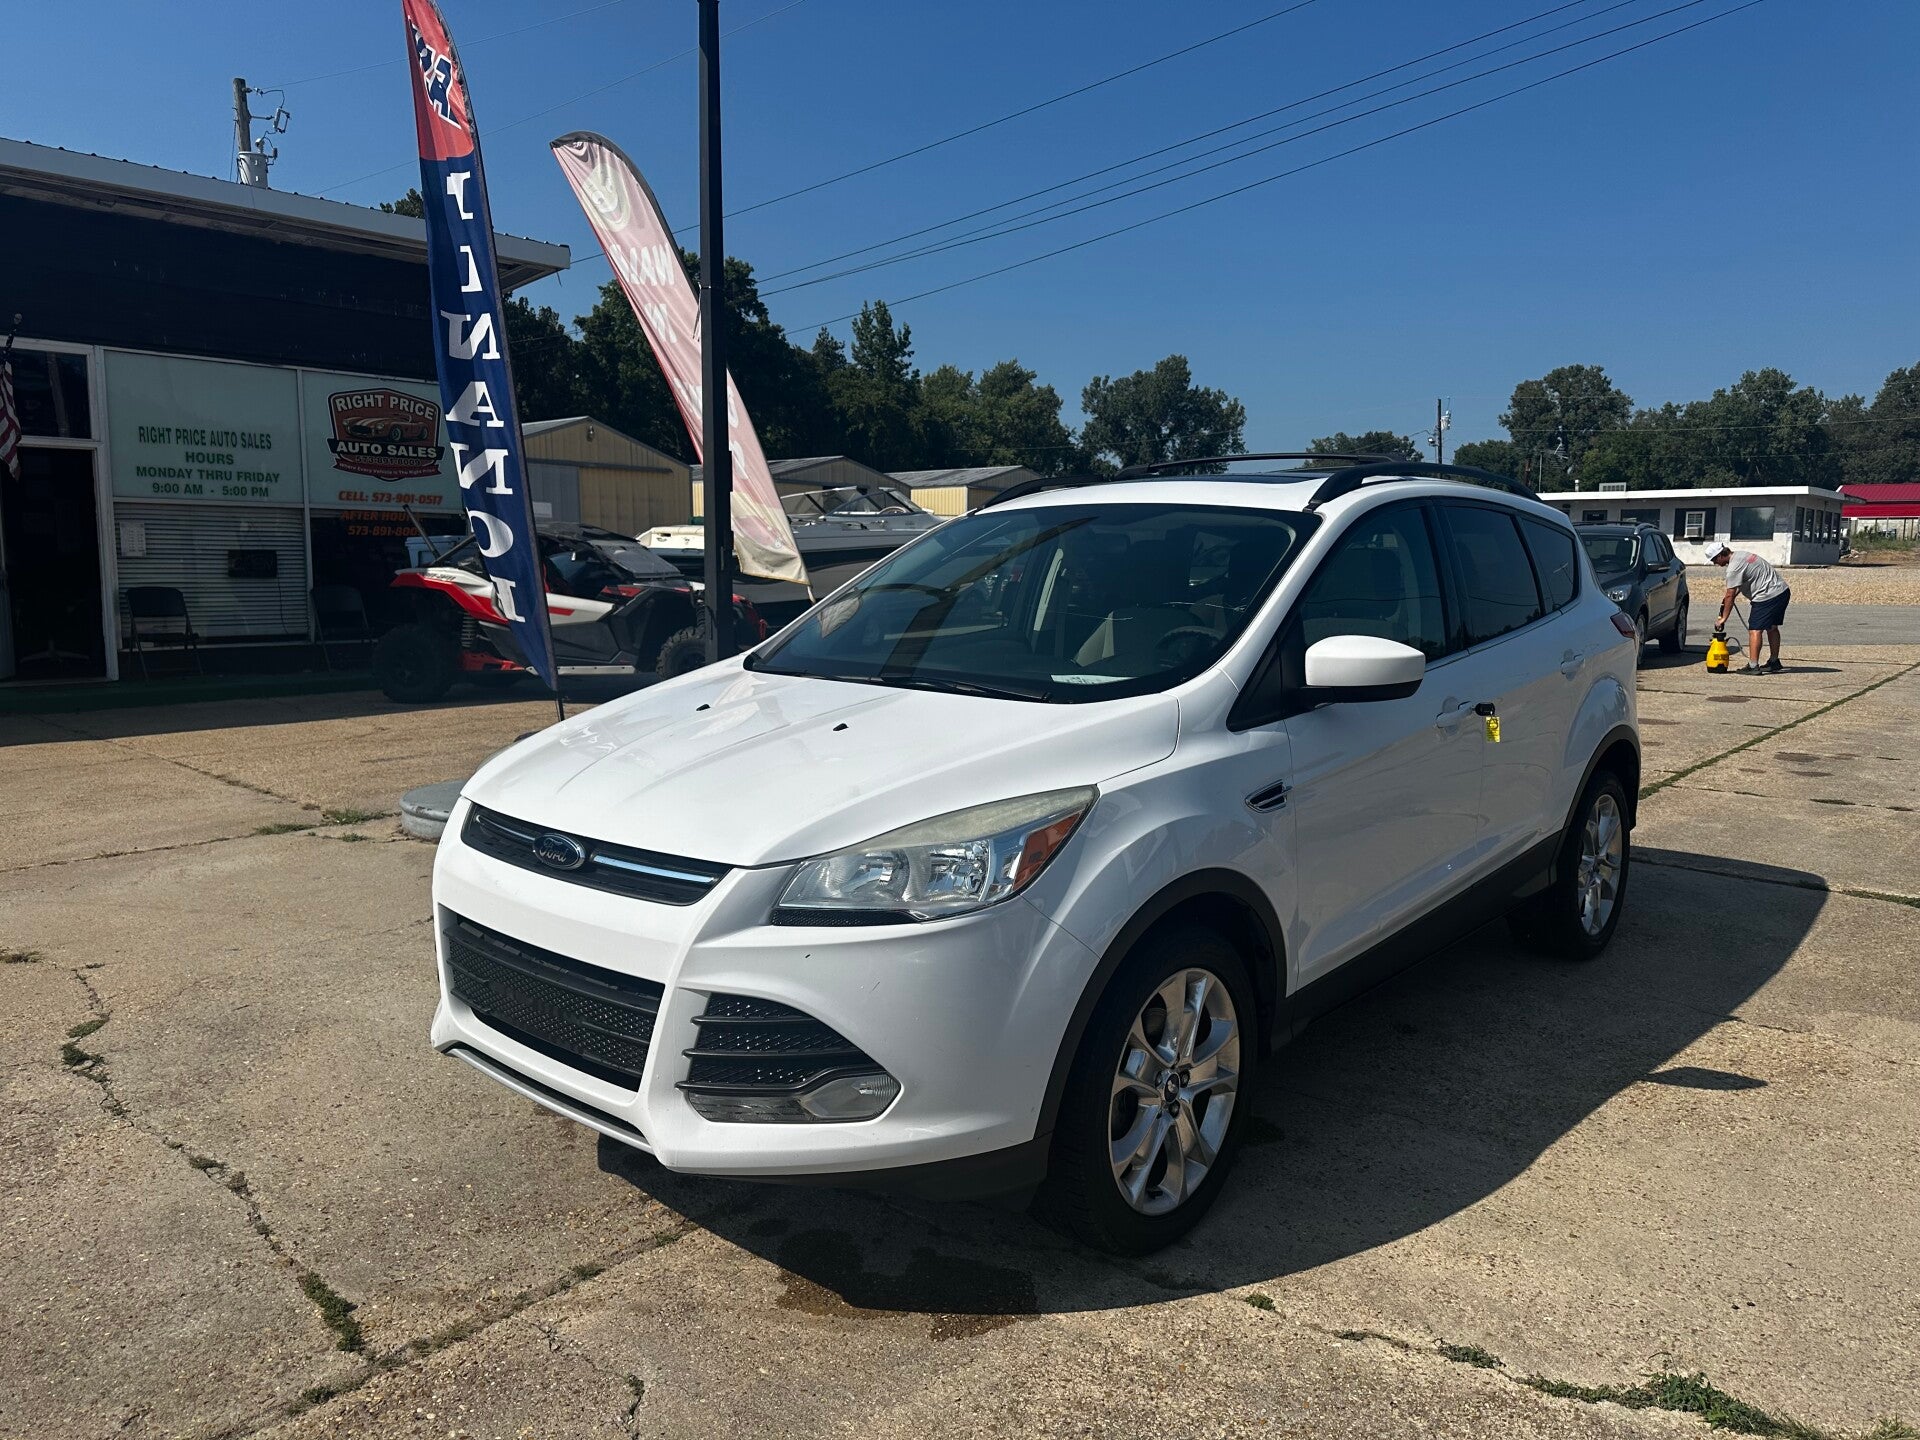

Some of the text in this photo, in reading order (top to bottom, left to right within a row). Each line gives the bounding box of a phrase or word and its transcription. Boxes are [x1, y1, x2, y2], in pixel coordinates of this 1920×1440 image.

[335, 394, 435, 420] RIGHT PRICE
[138, 426, 272, 450] RIGHT PRICE AUTO SALES
[336, 441, 438, 458] AUTO SALES
[185, 451, 235, 465] HOURS
[136, 466, 280, 483] MONDAY THRU FRIDAY
[152, 483, 180, 494] 9:00
[183, 484, 203, 495] AM
[222, 485, 248, 497] 5:00
[251, 487, 269, 497] PM
[338, 490, 443, 505] CELL: 573-901-0517
[341, 510, 378, 520] AFTER
[347, 525, 424, 537] 573-891-800
